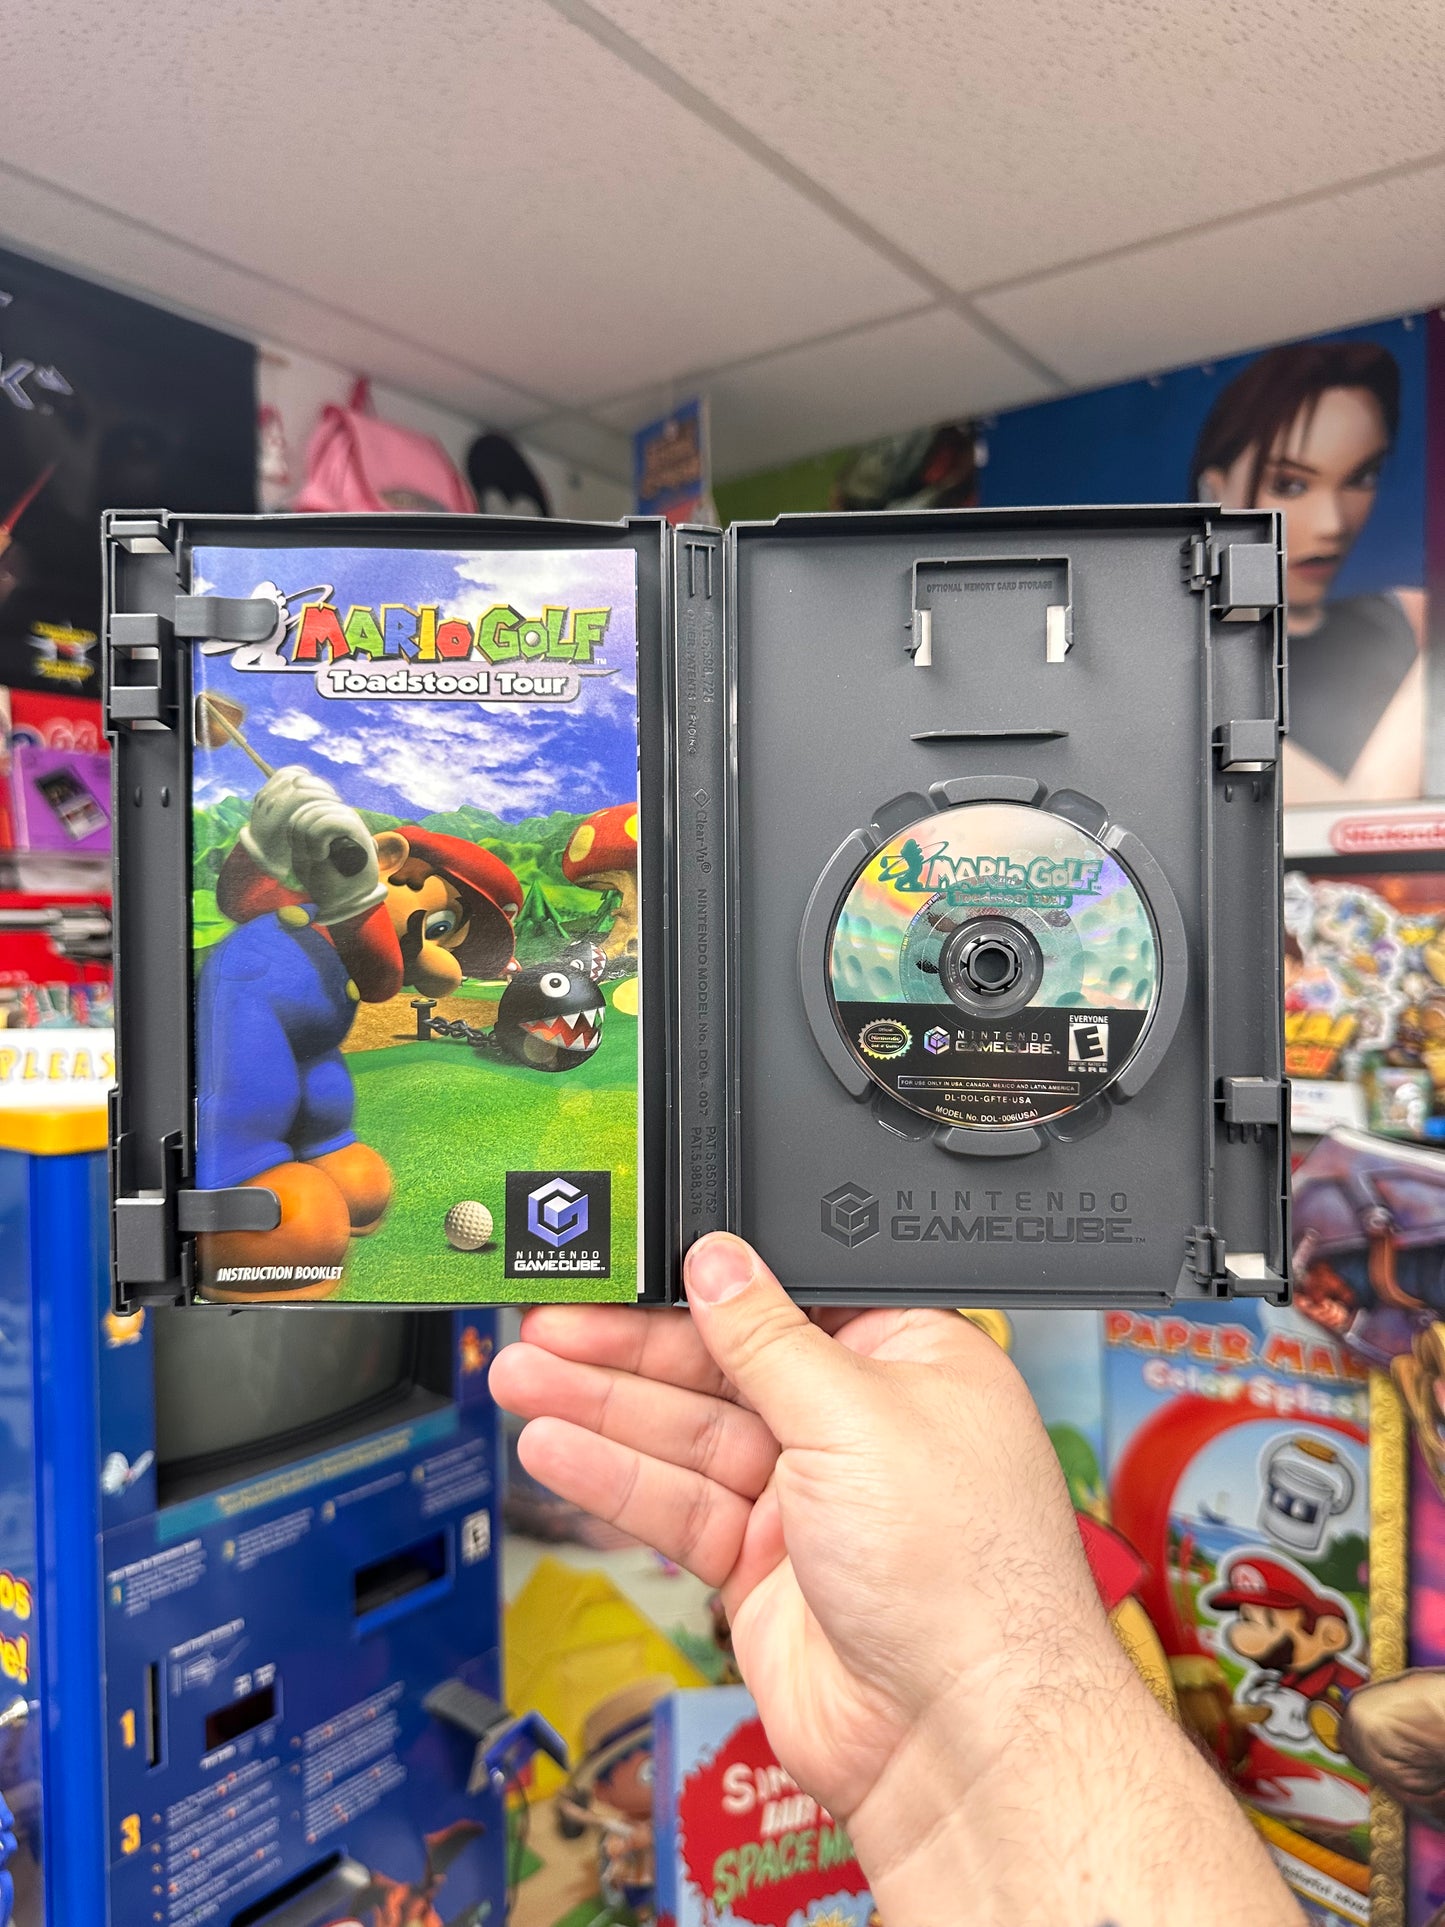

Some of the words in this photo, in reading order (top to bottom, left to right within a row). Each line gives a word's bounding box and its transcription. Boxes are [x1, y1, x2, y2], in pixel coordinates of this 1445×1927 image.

[926, 582, 962, 593] OPTIONAL
[964, 582, 996, 592] MEMORY
[997, 581, 1017, 591] CARD
[1018, 580, 1053, 590] STORAGE
[292, 603, 474, 664] MARIO
[474, 603, 612, 665] GOLF
[686, 609, 696, 647] OTHER
[329, 671, 489, 694] Toadstool
[497, 673, 568, 695] Tour
[686, 651, 696, 700] PATENTS
[686, 704, 697, 754] PENDING
[926, 856, 1026, 889] MARIO
[1028, 856, 1104, 891] GOLF
[697, 889, 708, 965] NINTENDO
[697, 968, 708, 1020] MODEL
[1069, 1014, 1109, 1024] EVERYONE
[698, 1022, 708, 1046] No.
[957, 1030, 1052, 1042] NINTENDO
[1073, 1025, 1104, 1060] E
[955, 1040, 1053, 1055] GAMECUBE
[944, 1093, 1032, 1105] DL-DOL-GFTE-USA
[1030, 1083, 1047, 1091] LATIN
[935, 1104, 964, 1120] MODEL
[965, 1112, 979, 1122] No.
[980, 1108, 1039, 1123] DOL-006(USA)
[896, 1190, 1129, 1213] NINTENDO
[890, 1215, 1133, 1244] GAMECUBE
[514, 1259, 601, 1272] GAMECUBE
[516, 1250, 600, 1260] NINTENDO
[217, 1265, 293, 1281] INSTRUCTION
[295, 1265, 343, 1280] BOOKLET
[1104, 1311, 1256, 1364] PAPER
